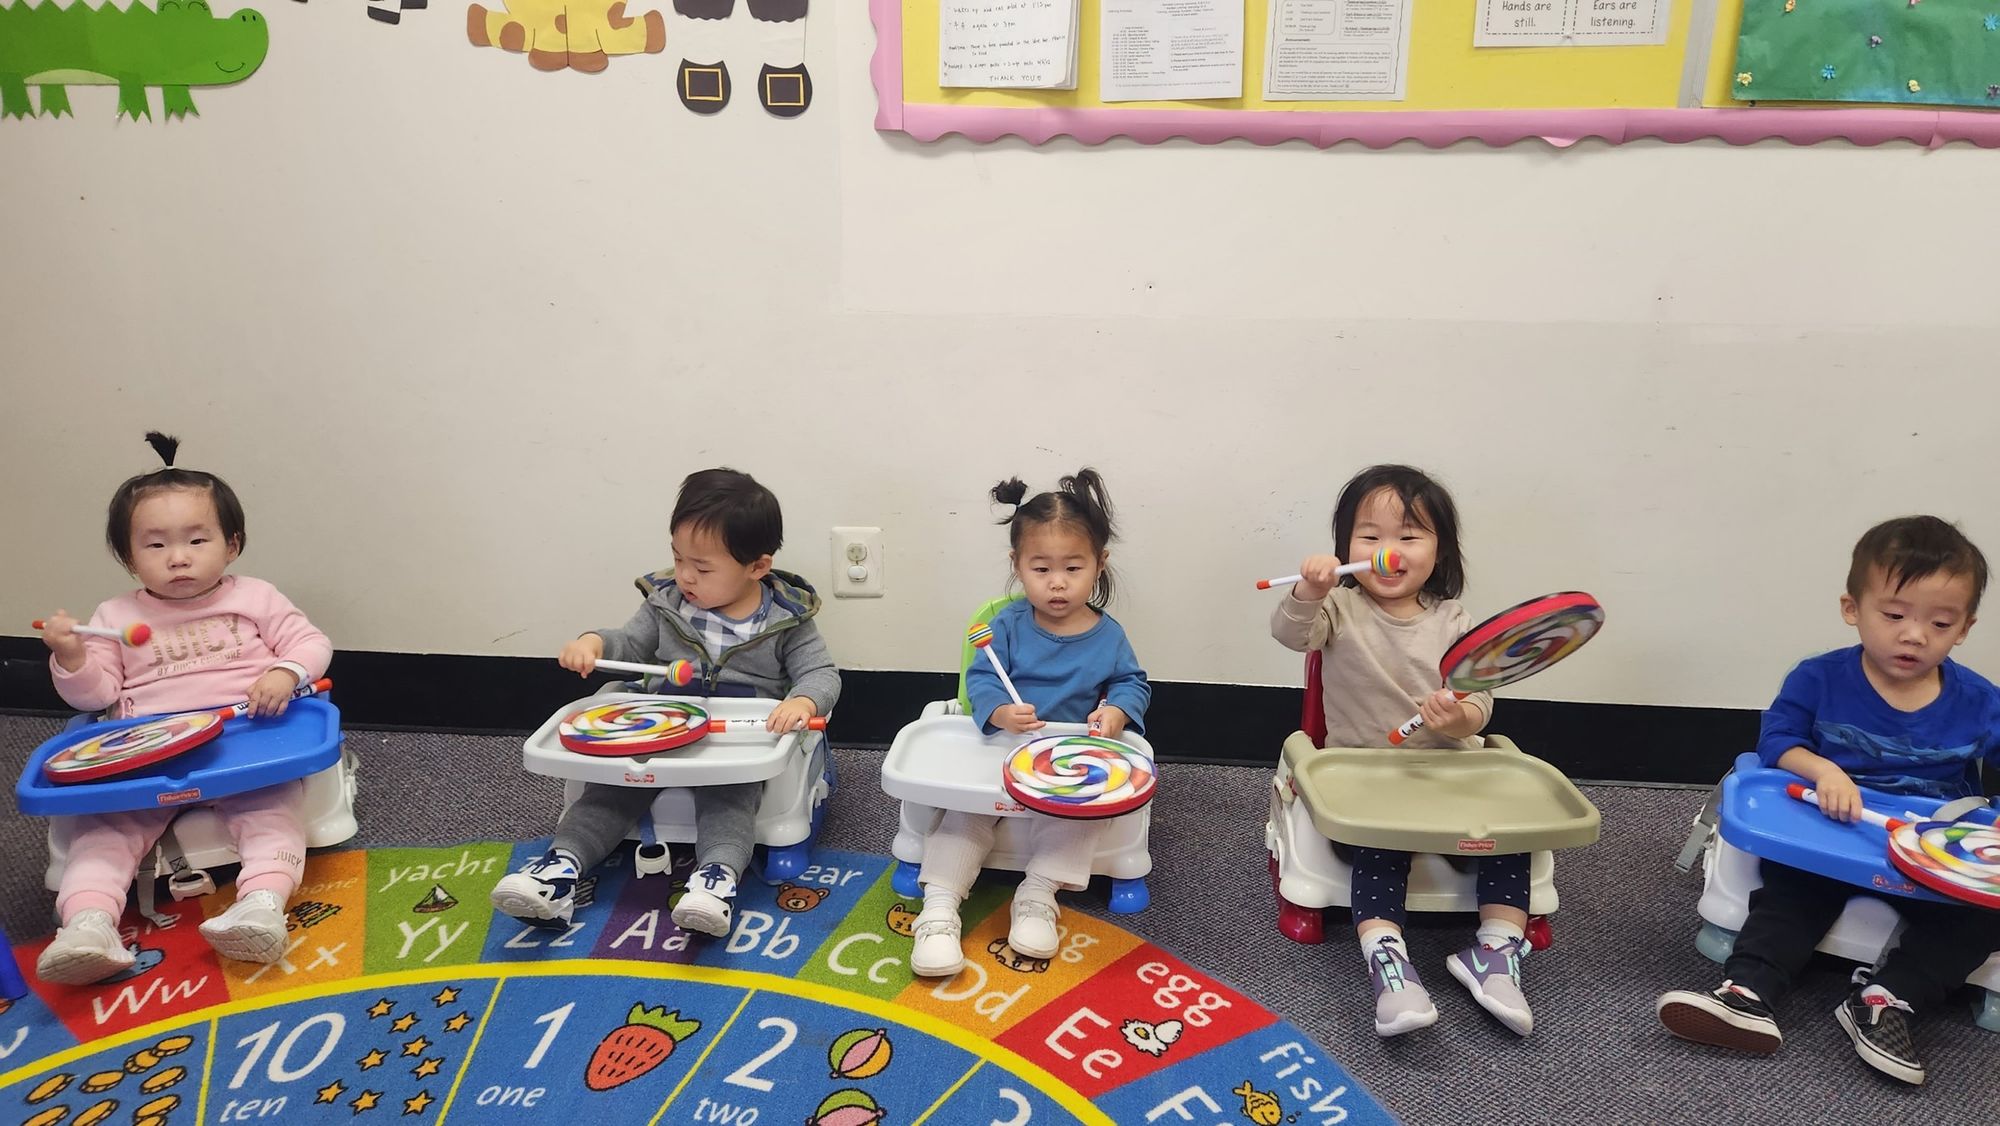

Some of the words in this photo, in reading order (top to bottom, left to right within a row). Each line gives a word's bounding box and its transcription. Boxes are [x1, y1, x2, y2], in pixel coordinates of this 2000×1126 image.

[1502, 1, 1531, 12] Hands
[1534, 2, 1552, 11] are
[1514, 18, 1537, 28] still.
[1590, 16, 1636, 28] listening.
[1593, 0, 1616, 10] Ears
[1619, 1, 1637, 10] are
[148, 614, 243, 667] JUICY
[273, 849, 302, 868] JUICY
[378, 851, 497, 893] yacht
[798, 865, 863, 887] ear
[396, 917, 470, 962] Yy
[609, 908, 692, 951] Aa
[725, 909, 800, 959] Bb
[827, 933, 902, 983] Cc
[92, 975, 208, 1025] Ww
[930, 958, 1031, 1023] Dd
[1136, 962, 1232, 1027] egg
[228, 1012, 346, 1089] 10
[523, 1001, 576, 1069] 1
[722, 1016, 798, 1092] 2
[1045, 1007, 1123, 1079] Ee
[476, 1085, 546, 1107] one
[1145, 1085, 1234, 1126] F
[1259, 1042, 1347, 1126] fish
[220, 1096, 288, 1122] ten
[693, 1097, 759, 1126] two
